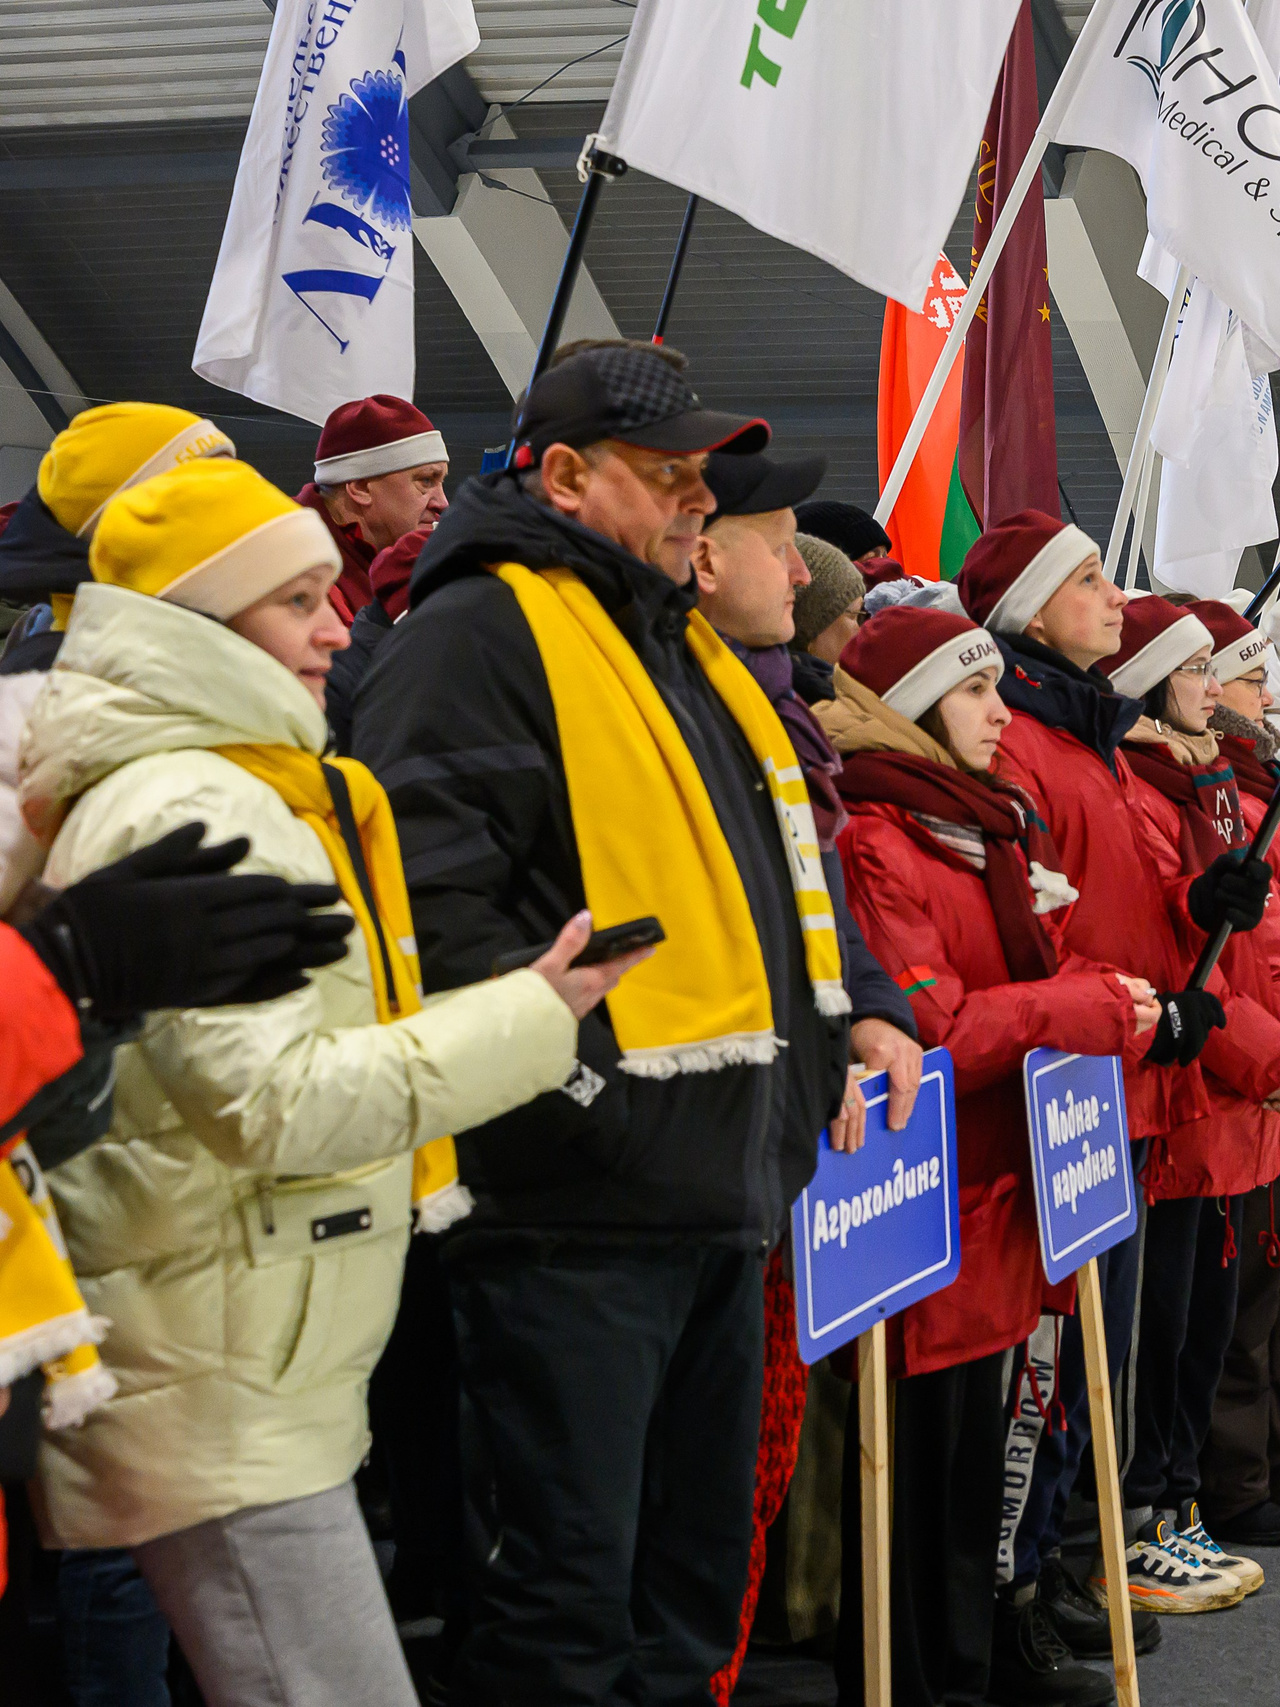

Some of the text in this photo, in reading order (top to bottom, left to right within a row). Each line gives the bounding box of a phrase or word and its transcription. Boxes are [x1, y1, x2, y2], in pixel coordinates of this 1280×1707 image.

[1158, 91, 1249, 176] Medical
[1243, 177, 1270, 201] &
[1045, 1089, 1100, 1150] Моднае
[813, 1156, 941, 1251] Агрохолдинг
[1052, 1140, 1117, 1215] народнае
